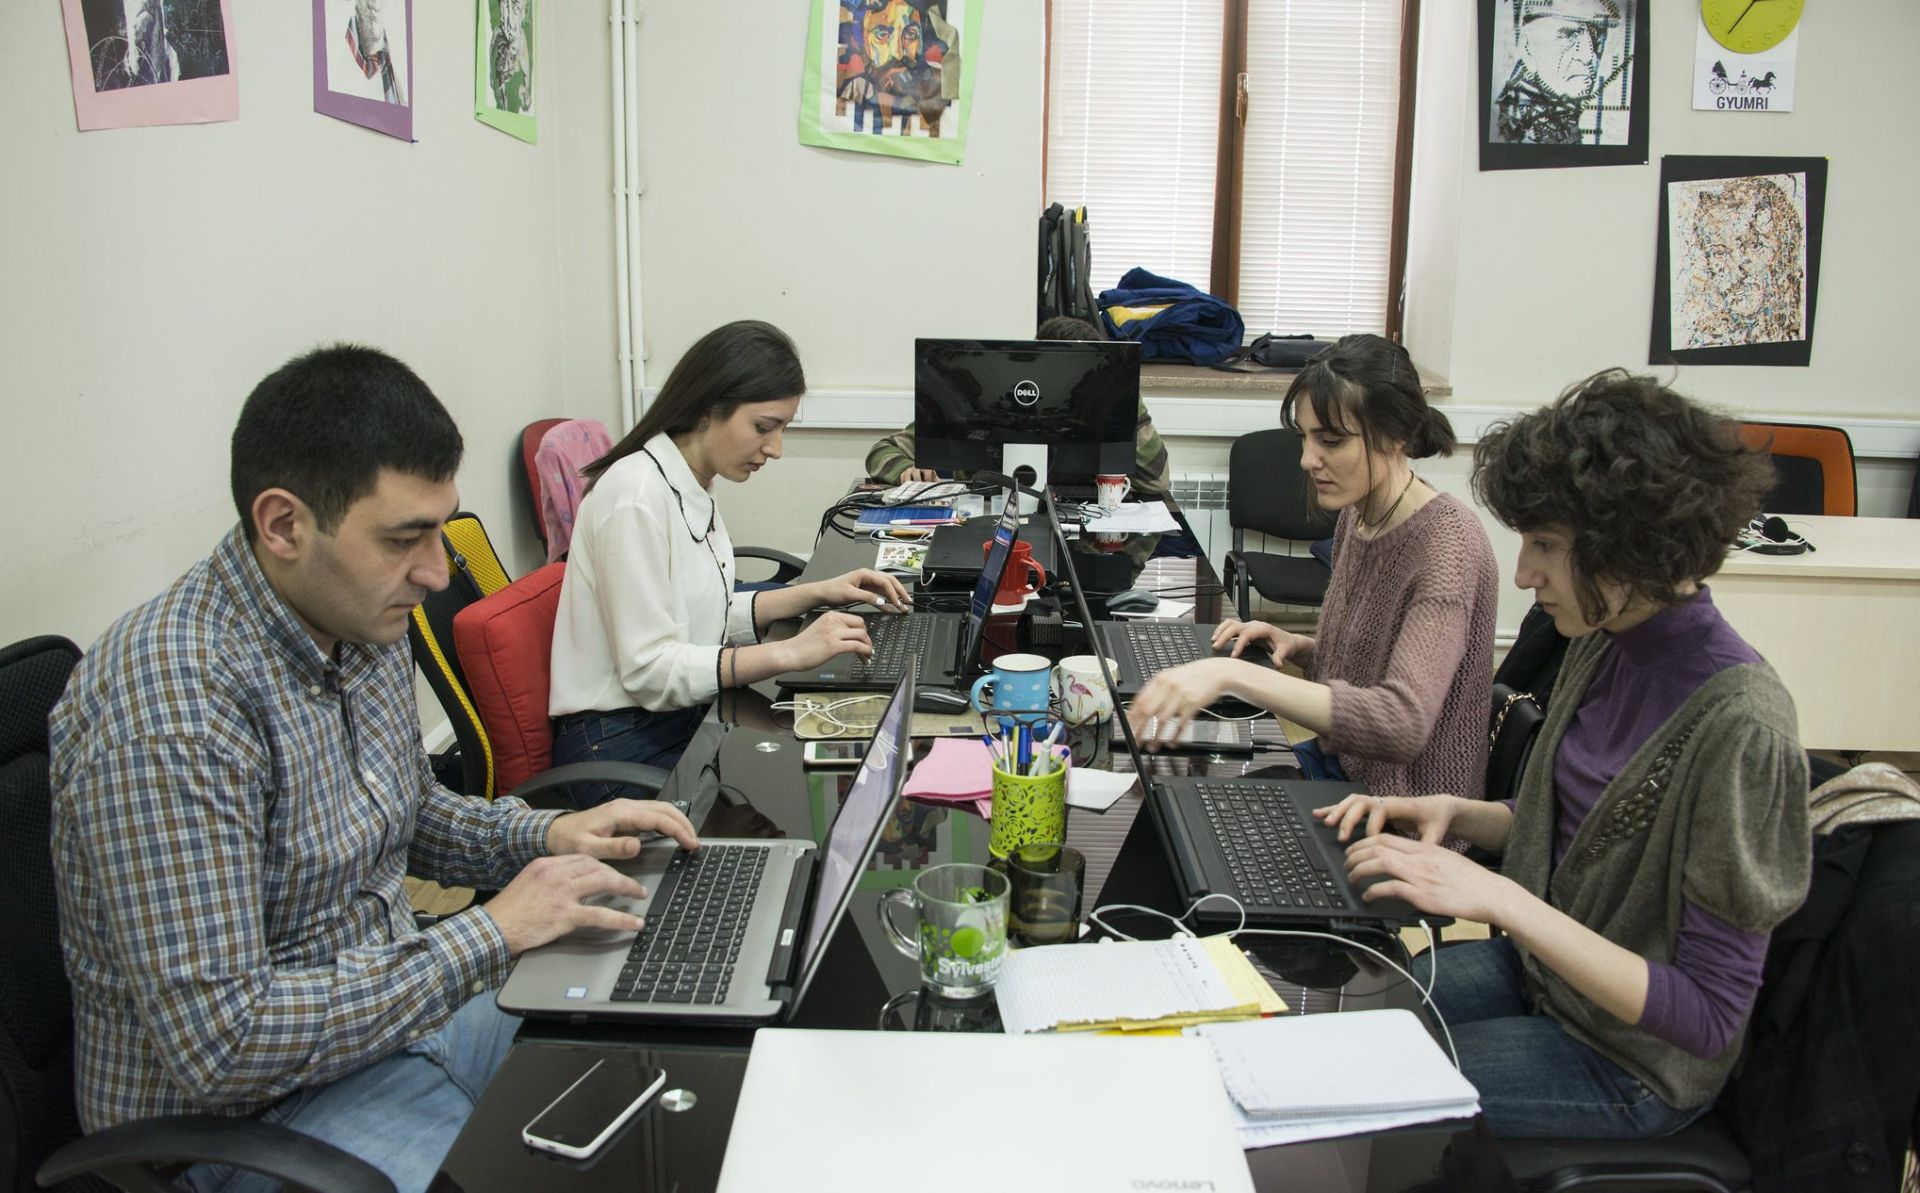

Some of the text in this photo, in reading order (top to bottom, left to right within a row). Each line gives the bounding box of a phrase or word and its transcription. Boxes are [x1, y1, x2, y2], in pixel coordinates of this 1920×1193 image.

[1716, 96, 1768, 110] GYUMRI
[1017, 389, 1037, 397] DELL
[1131, 1179, 1216, 1193] Lenovo
